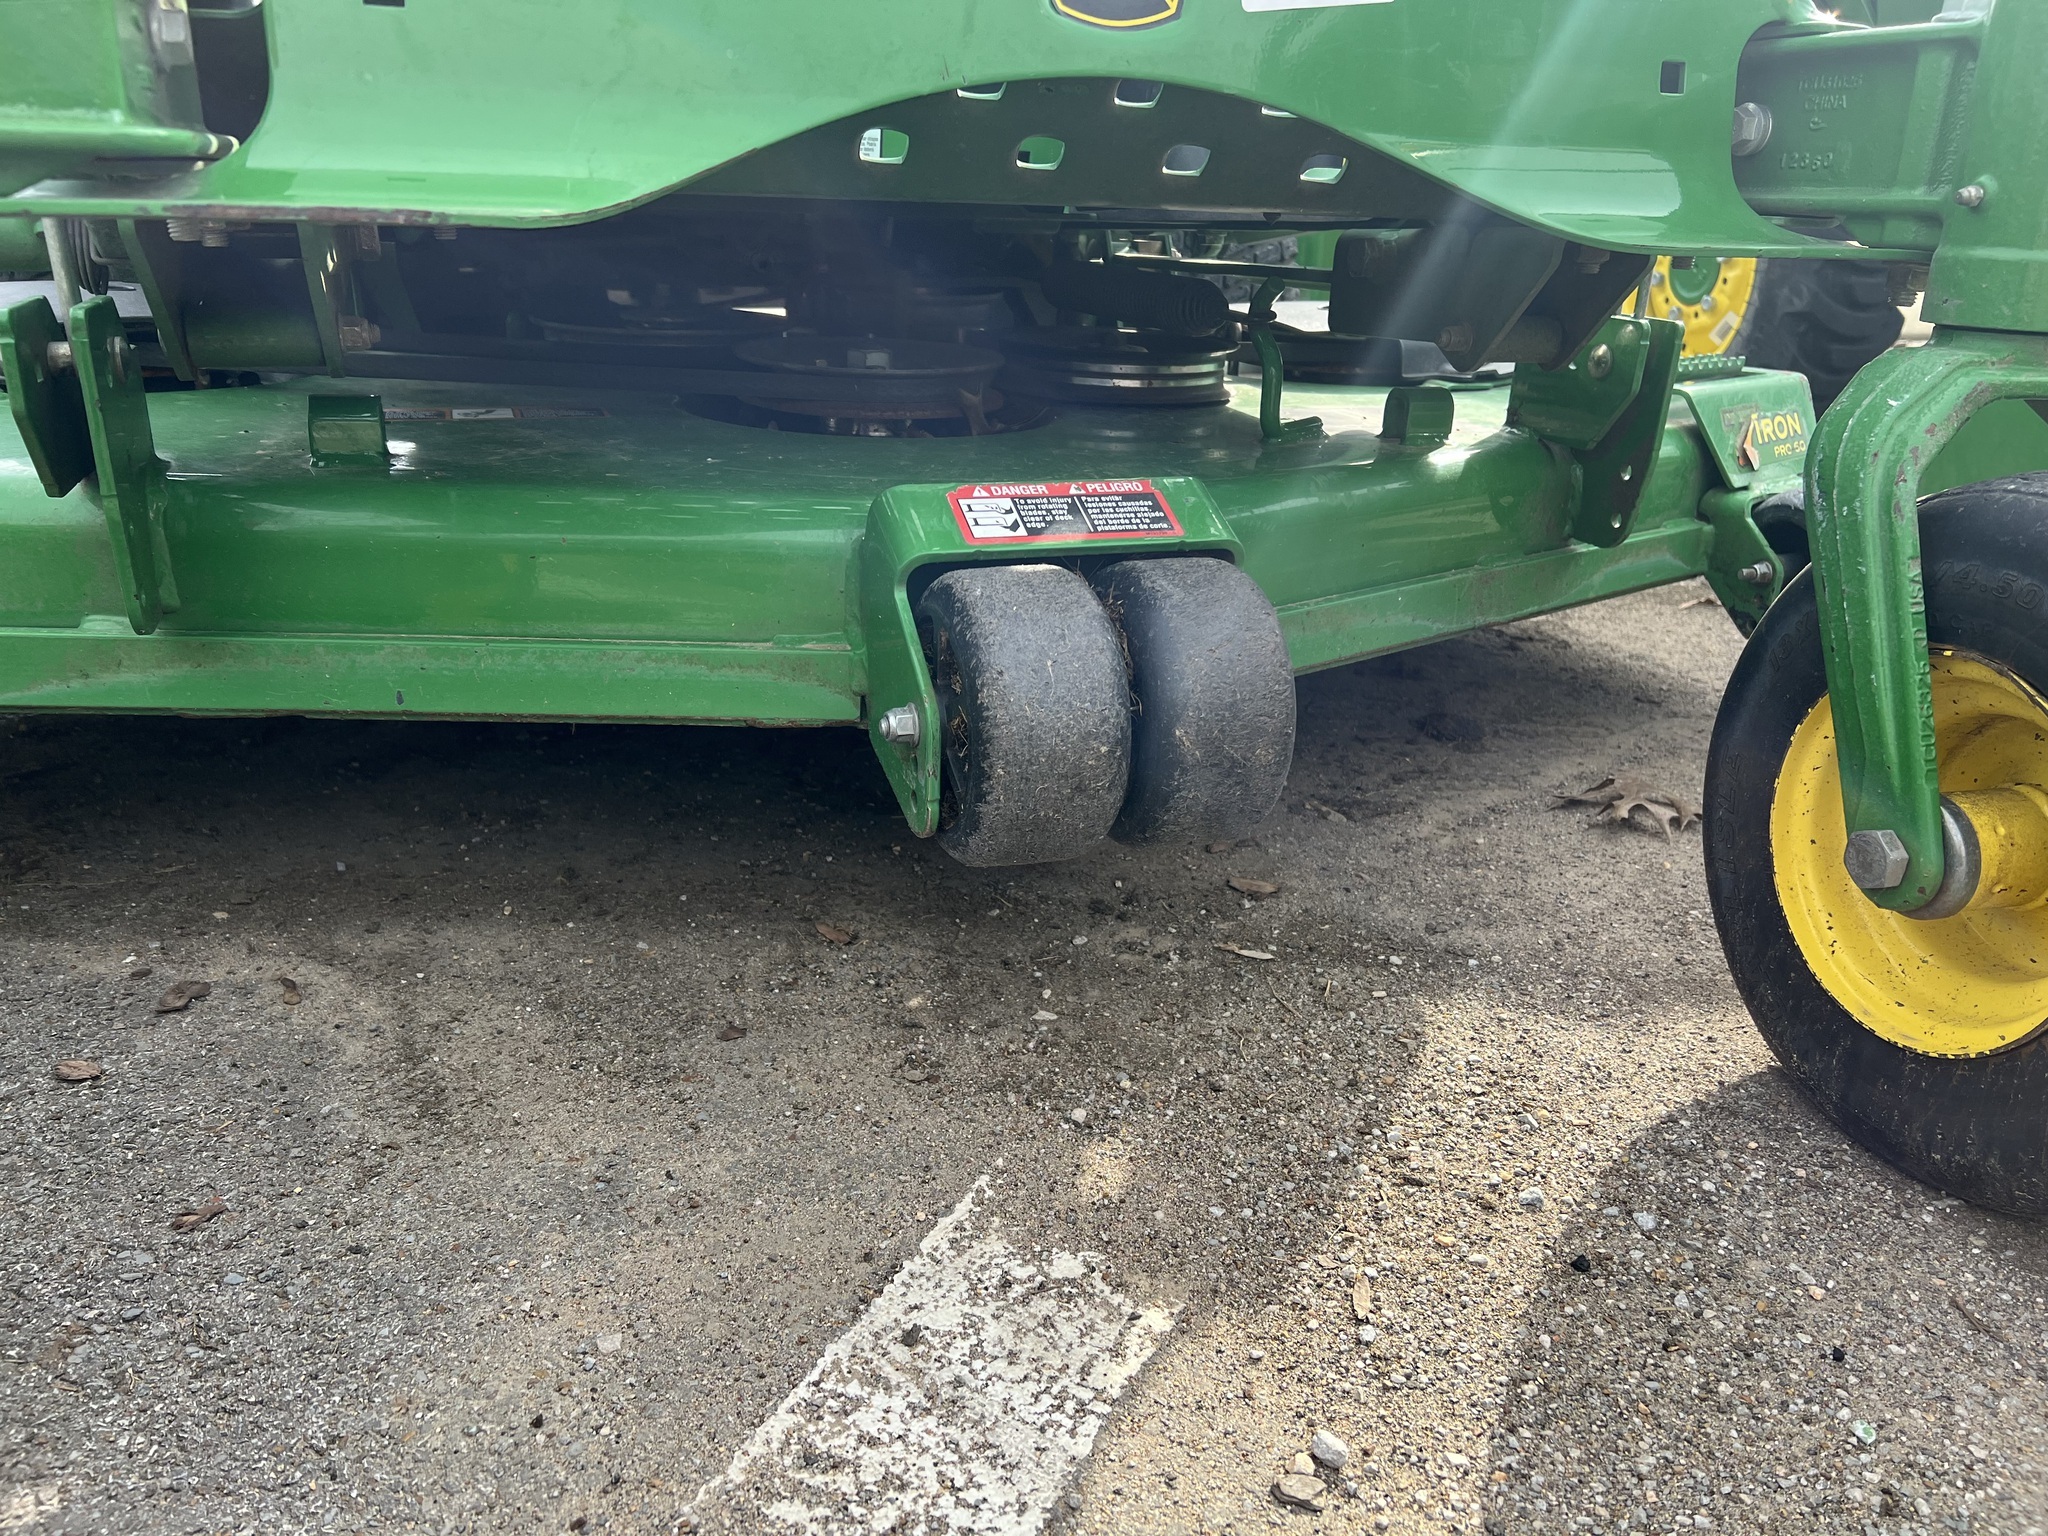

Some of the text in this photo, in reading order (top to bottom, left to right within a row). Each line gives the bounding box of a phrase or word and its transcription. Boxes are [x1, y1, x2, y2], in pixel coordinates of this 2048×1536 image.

[990, 485, 1049, 496] DANGER
[1086, 482, 1144, 493] PELIGRO
[1096, 524, 1138, 532] plataforma
[1908, 568, 1925, 615] USA
